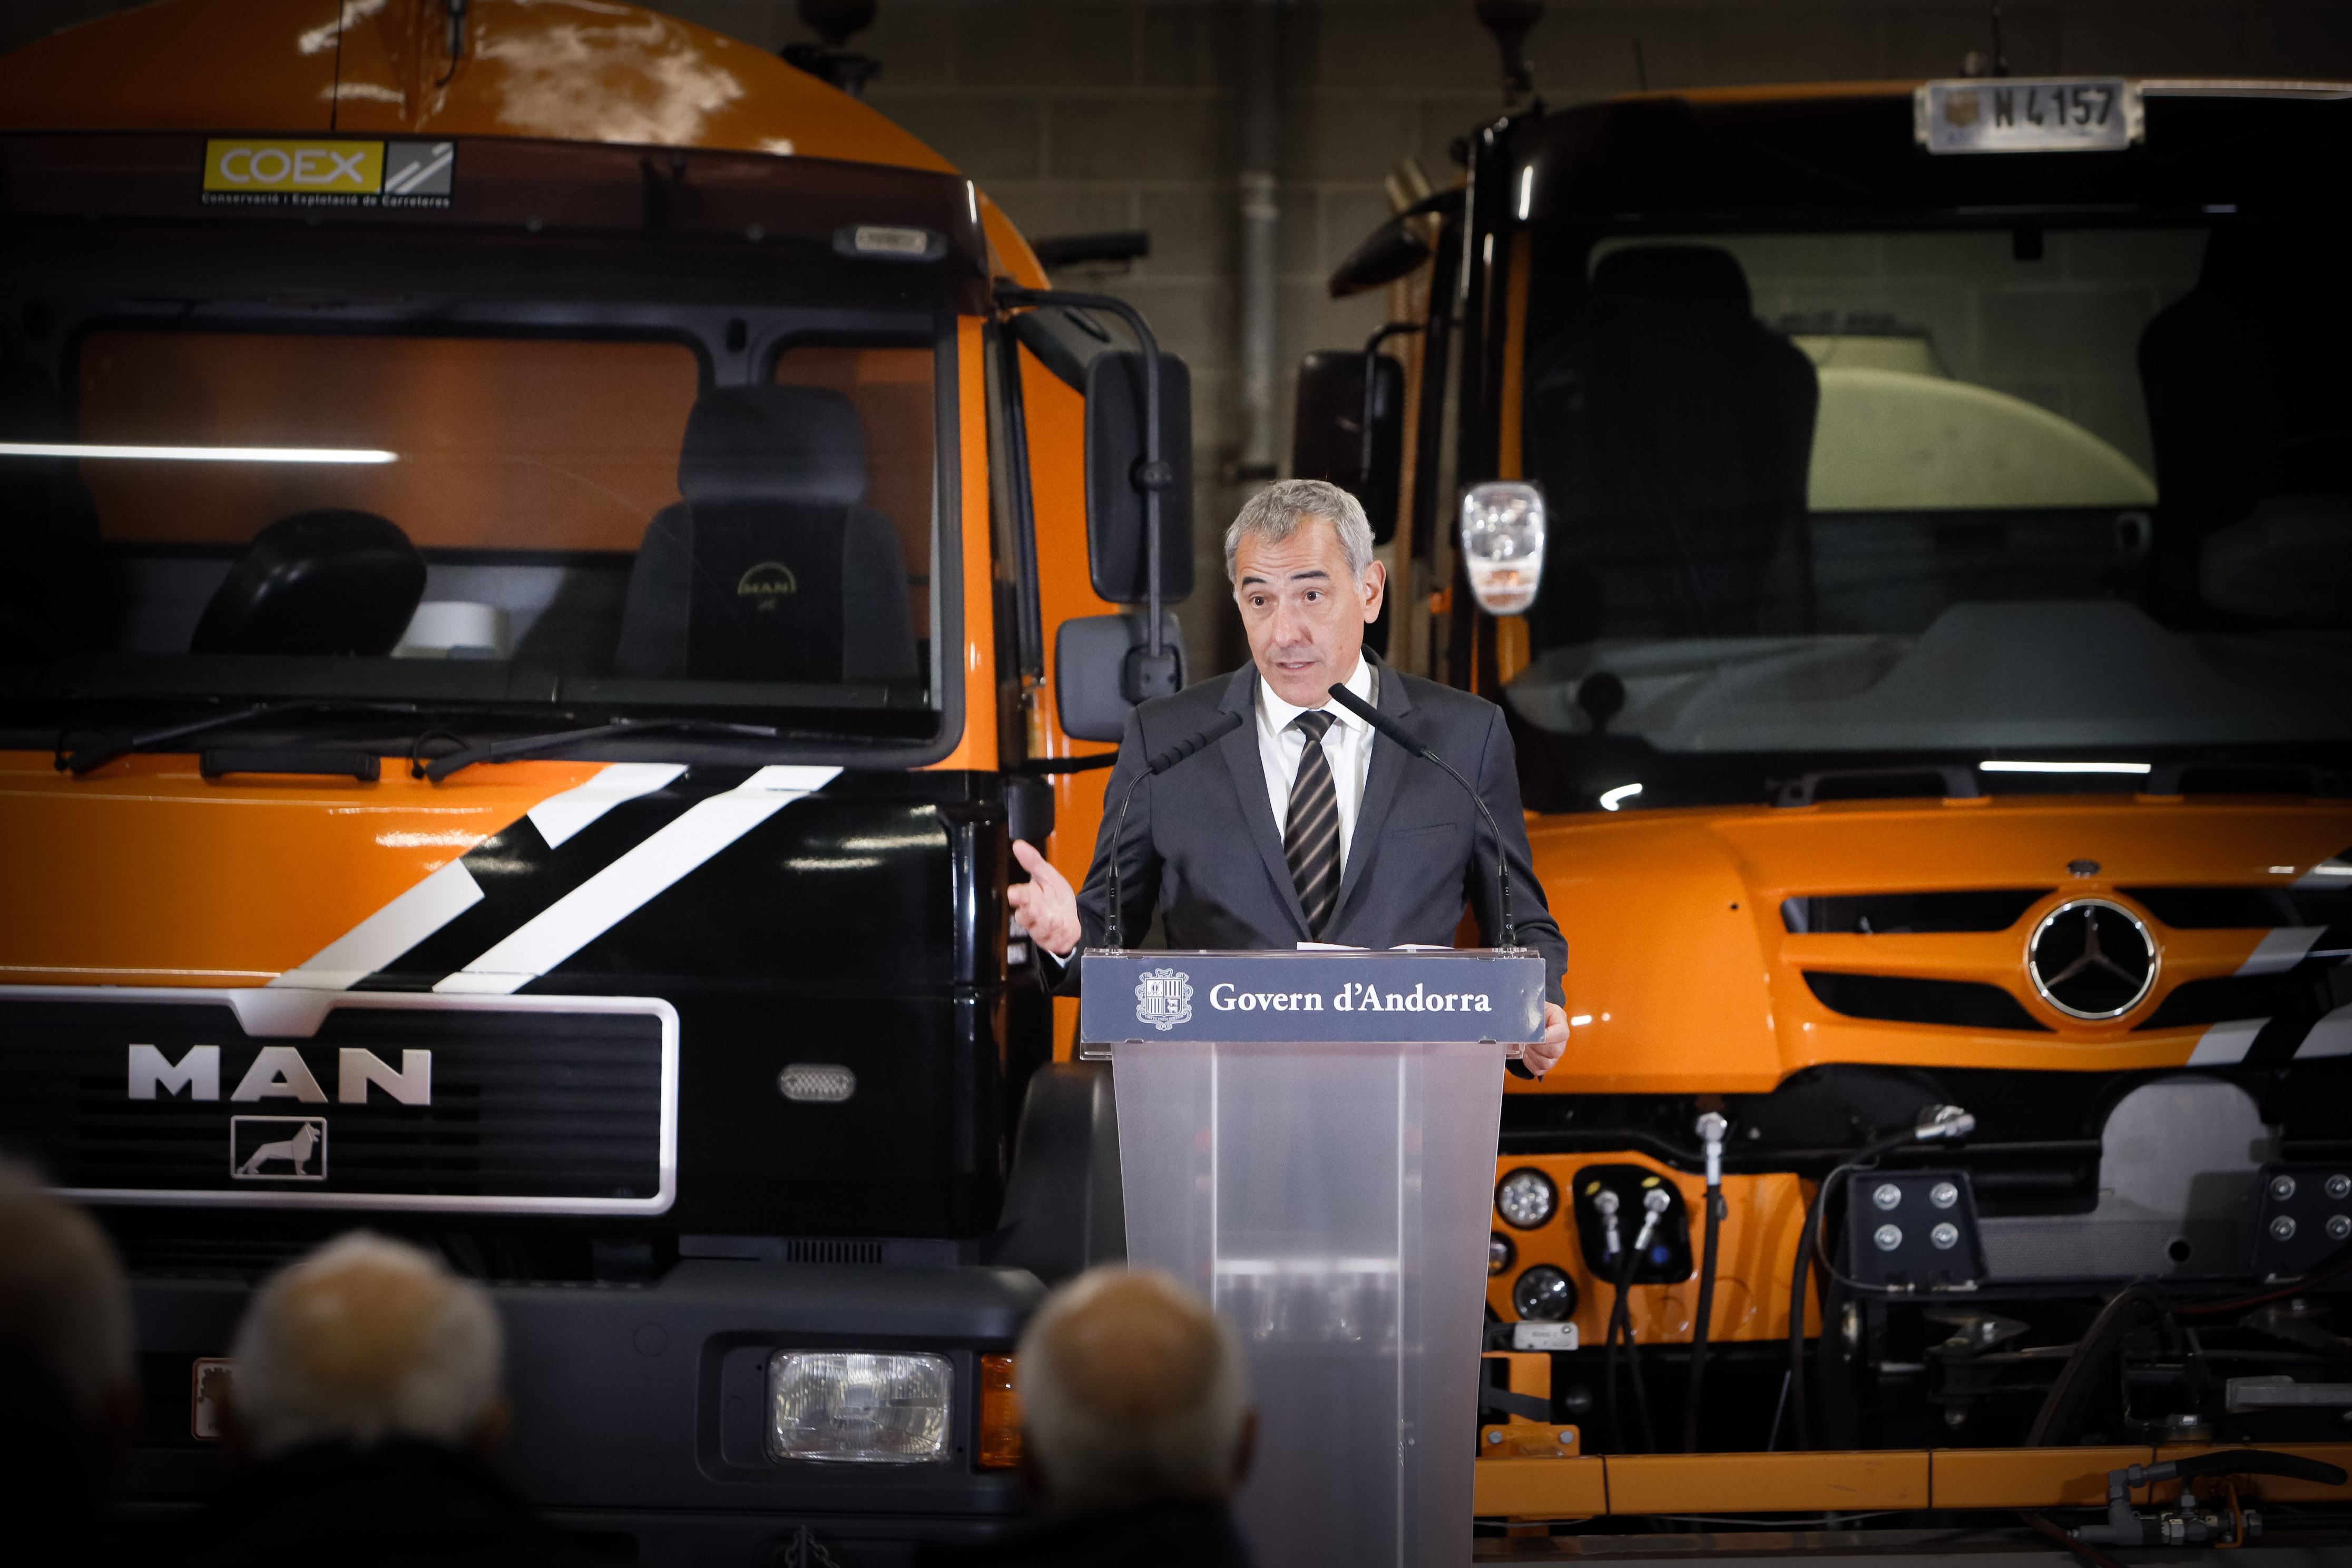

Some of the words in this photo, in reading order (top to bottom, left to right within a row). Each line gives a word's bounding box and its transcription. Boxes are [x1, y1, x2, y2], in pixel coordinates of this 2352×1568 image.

[220, 148, 366, 184] COEX
[1209, 983, 1324, 1011] Govern
[1333, 982, 1492, 1012] d’Andorra
[129, 1044, 431, 1106] MAN
